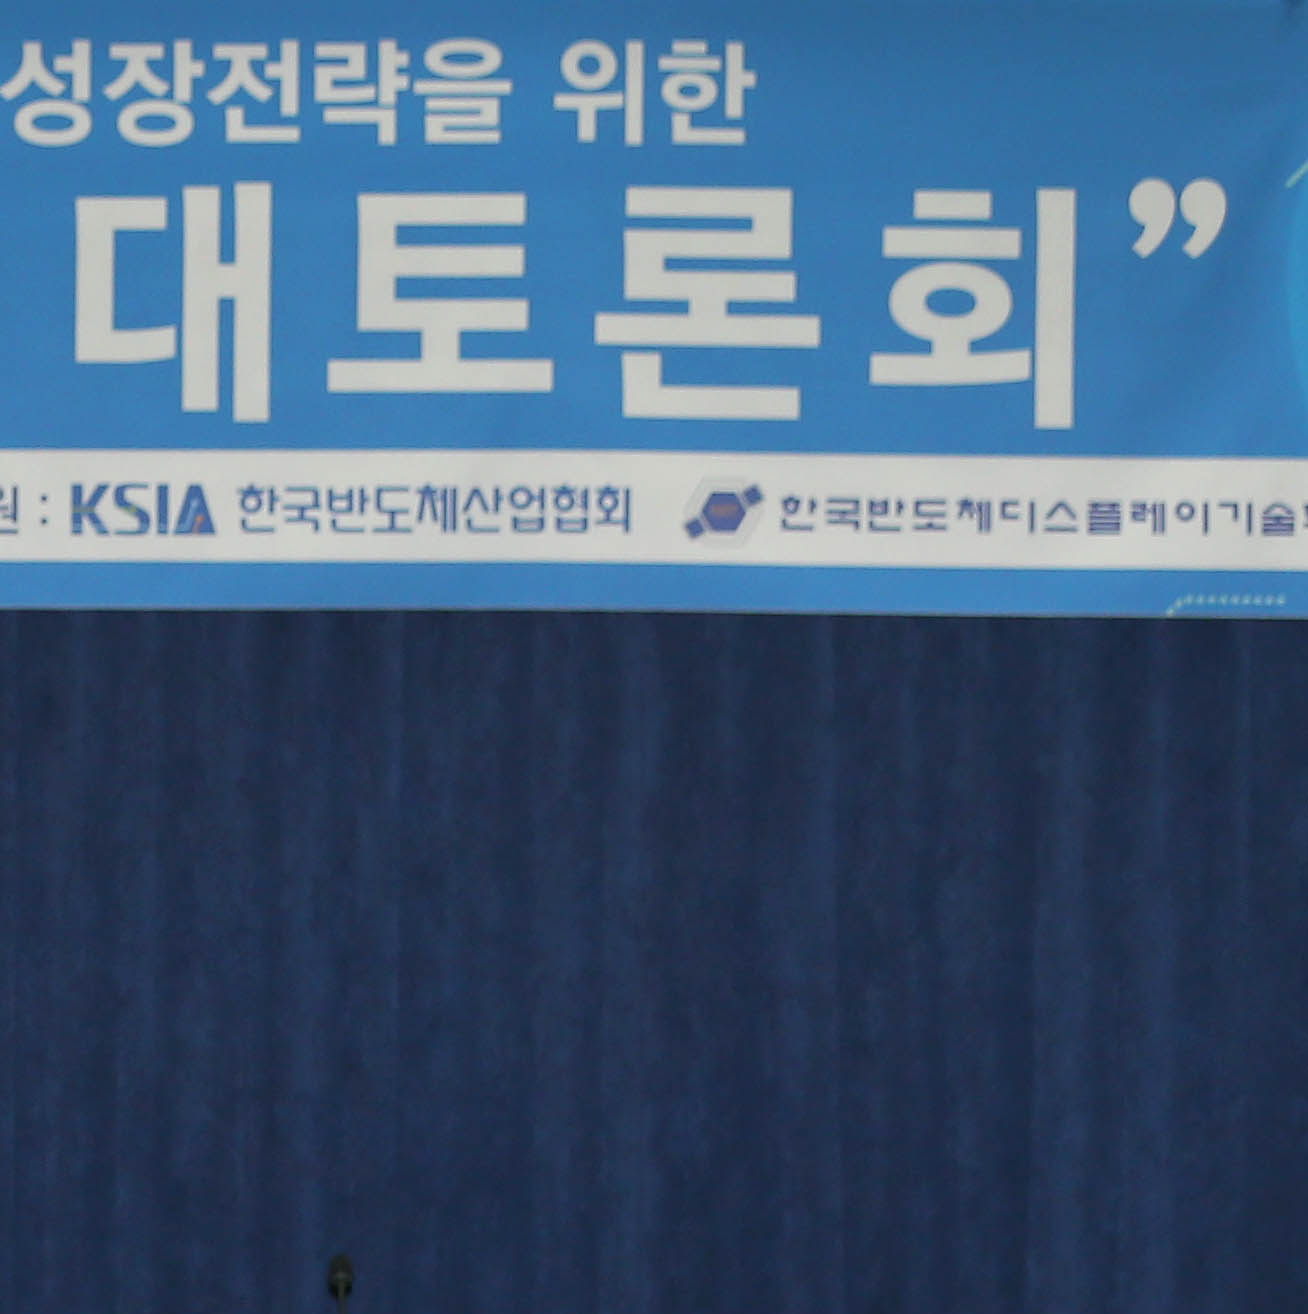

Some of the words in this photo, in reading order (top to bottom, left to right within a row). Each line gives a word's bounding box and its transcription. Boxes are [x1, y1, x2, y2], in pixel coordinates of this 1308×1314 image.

[0, 39, 513, 146] 성장전략을
[554, 41, 756, 145] 위한
[71, 483, 216, 536] KSIA
[240, 484, 631, 533] 한국반도체산업협회
[780, 495, 1308, 538] 한국반도체디스플레이기술
